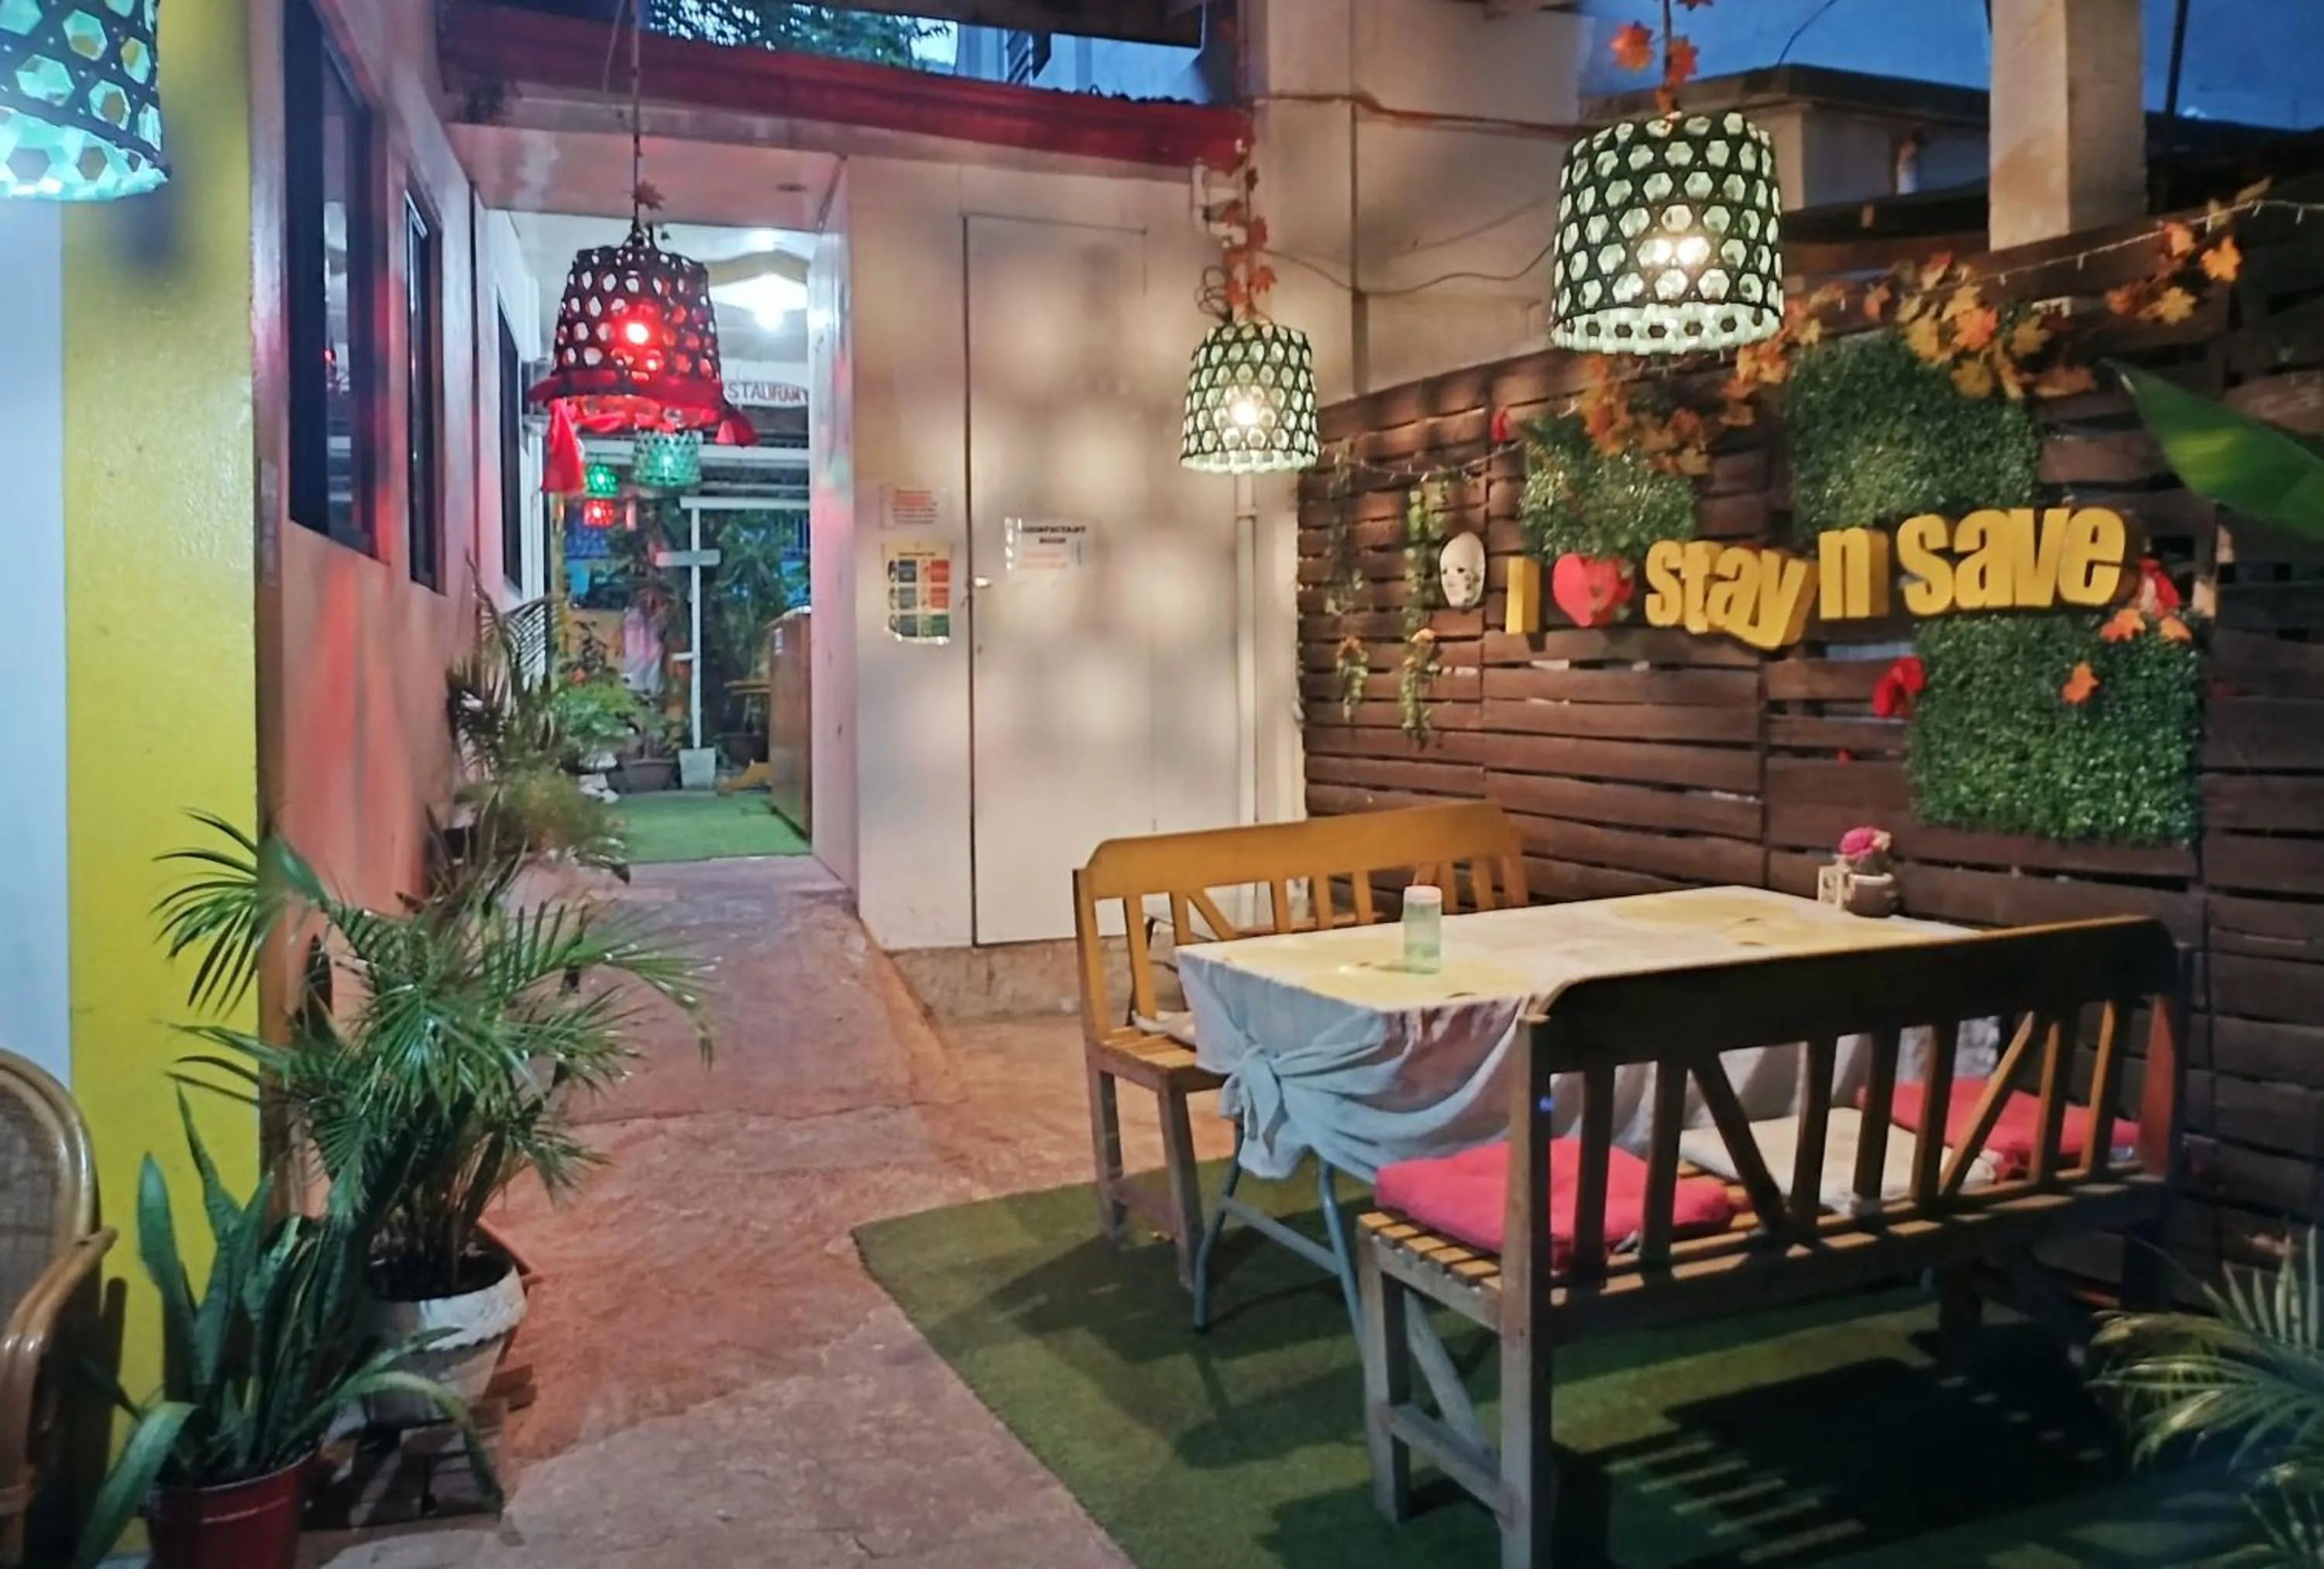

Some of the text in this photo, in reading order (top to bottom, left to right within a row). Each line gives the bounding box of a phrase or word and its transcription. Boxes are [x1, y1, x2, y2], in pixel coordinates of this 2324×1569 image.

[1645, 540, 1812, 651] stay
[1818, 527, 1882, 620] n
[1896, 506, 2127, 616] save
